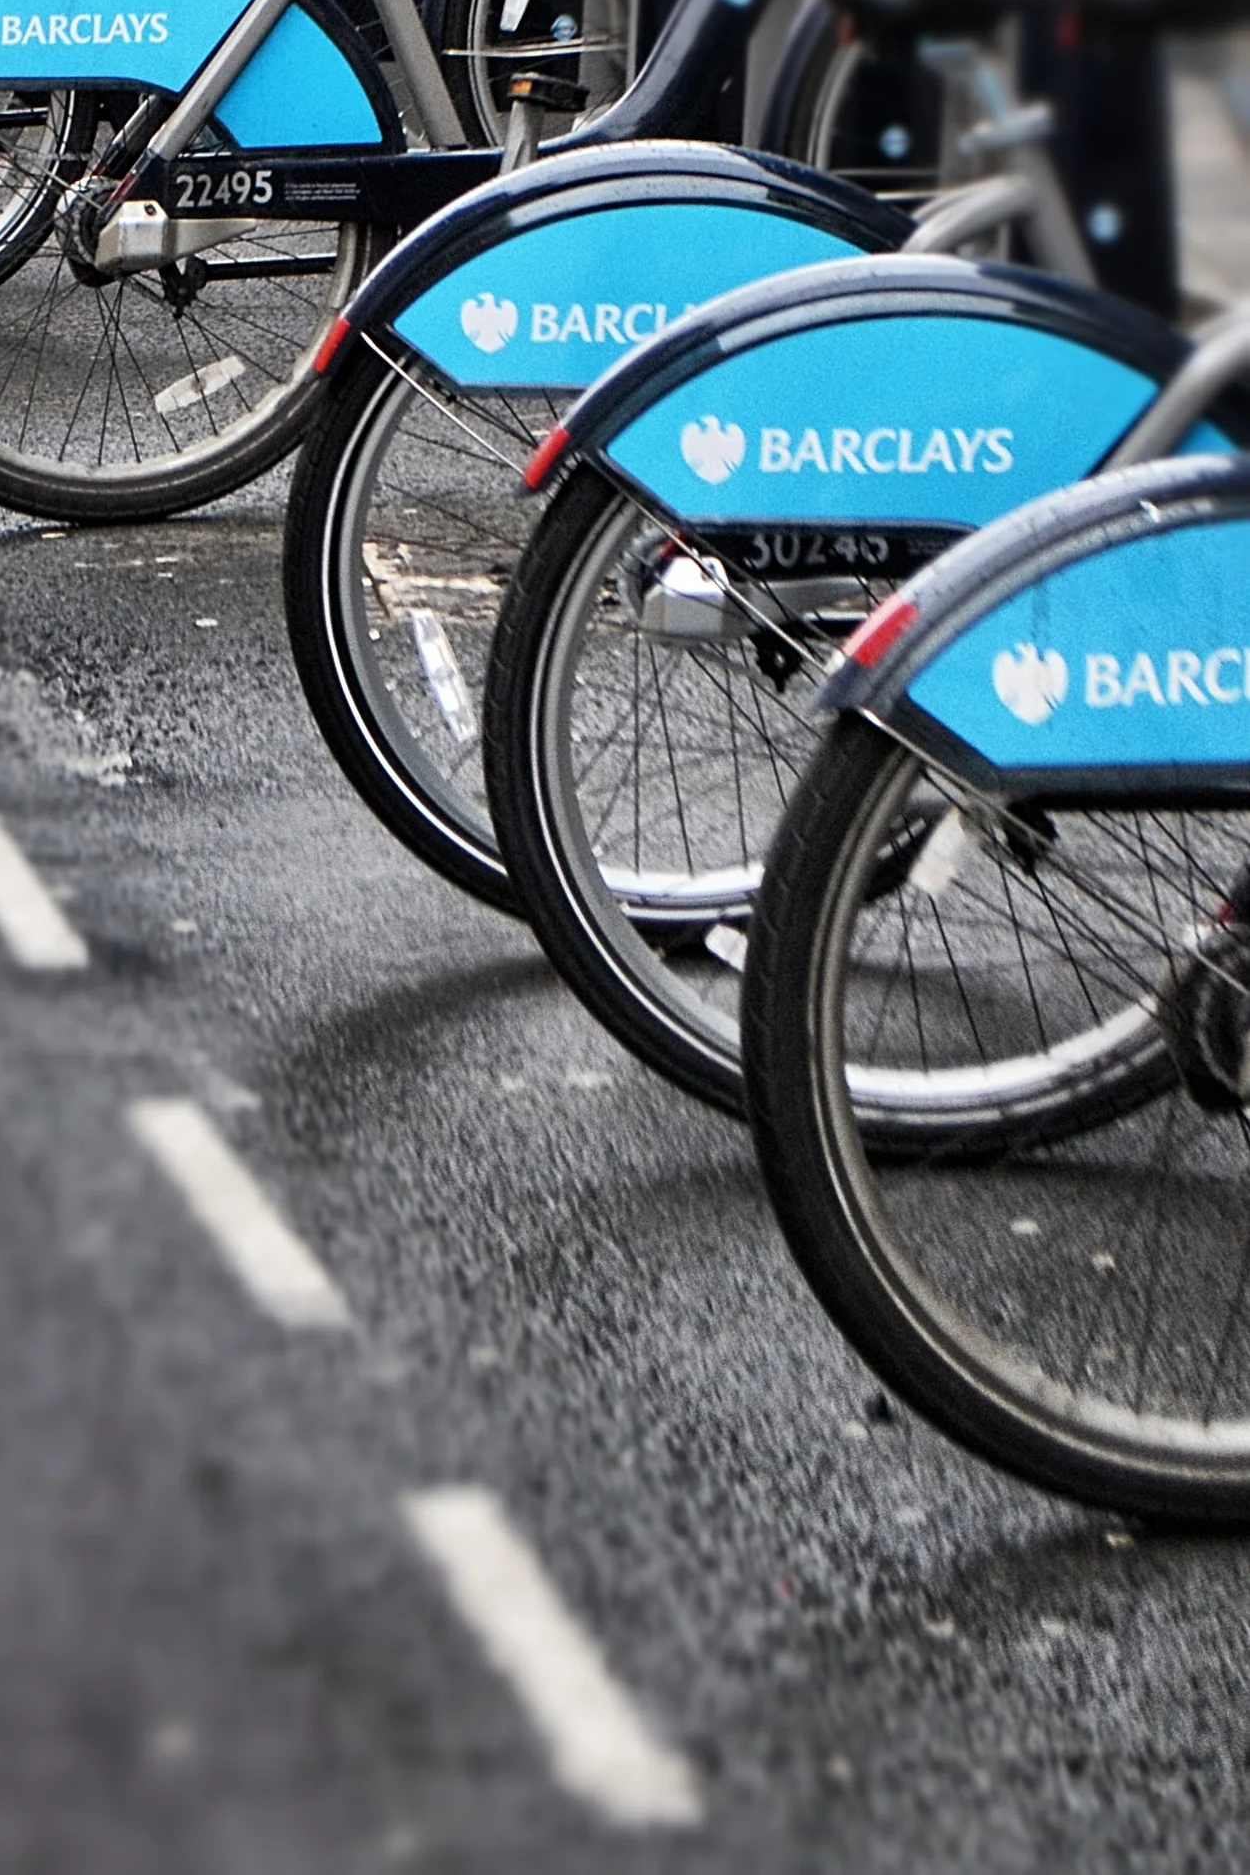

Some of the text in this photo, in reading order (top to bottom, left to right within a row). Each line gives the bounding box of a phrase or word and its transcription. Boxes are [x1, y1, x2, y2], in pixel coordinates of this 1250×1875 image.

[1, 12, 169, 45] BARCLAYS
[176, 170, 274, 208] 22495
[530, 302, 695, 345] BARCL
[758, 427, 1014, 474] BARCLAYS
